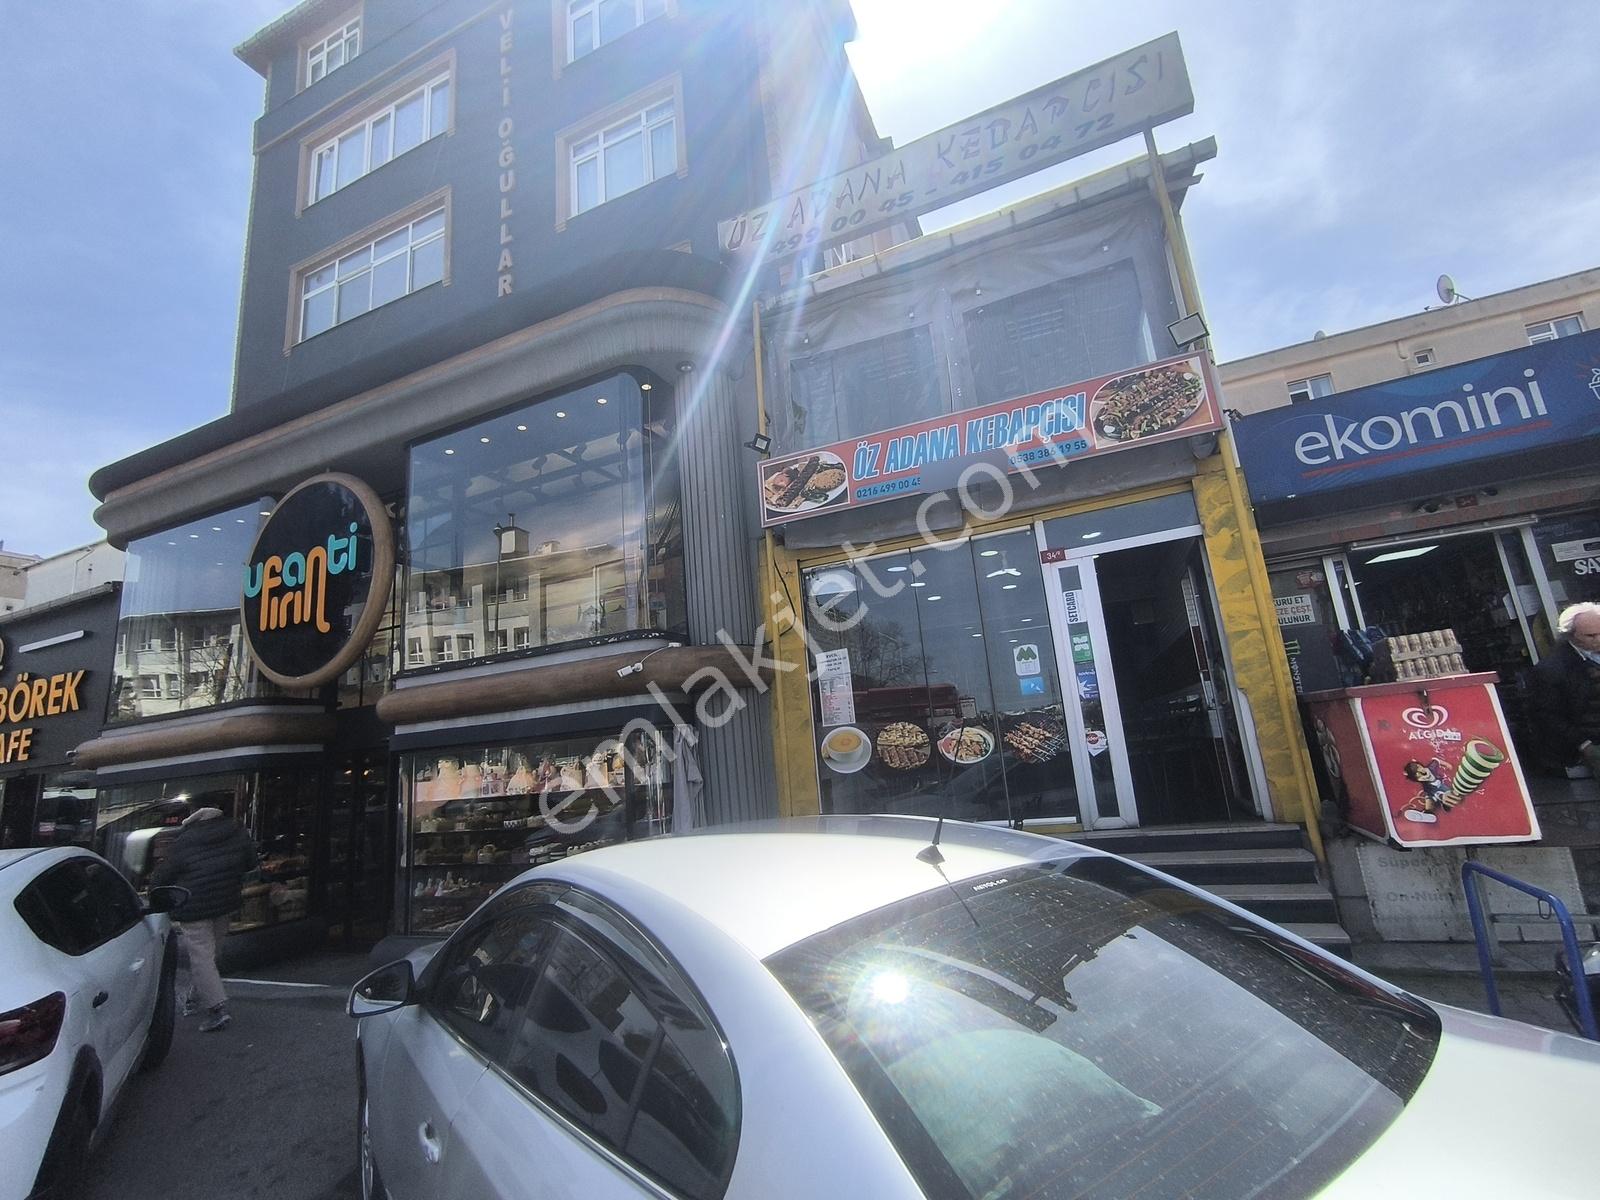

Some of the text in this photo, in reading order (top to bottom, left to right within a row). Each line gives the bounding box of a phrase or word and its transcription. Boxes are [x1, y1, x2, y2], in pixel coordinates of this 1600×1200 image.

[830, 208, 867, 232] 00
[950, 156, 1005, 185] 415
[1018, 136, 1063, 160] 04
[1074, 113, 1115, 138] 72
[1294, 368, 1548, 465] ekomini
[853, 391, 1087, 481] ÖZ ADANA KEBAPÇISI
[1074, 439, 1088, 450] 55
[856, 487, 878, 498] 0216
[880, 482, 896, 493] 499
[898, 479, 910, 489] 00
[1574, 556, 1600, 575] SA
[1065, 592, 1079, 622] SETCARD
[1294, 596, 1305, 604] ET
[1278, 614, 1311, 625] ULUNUR
